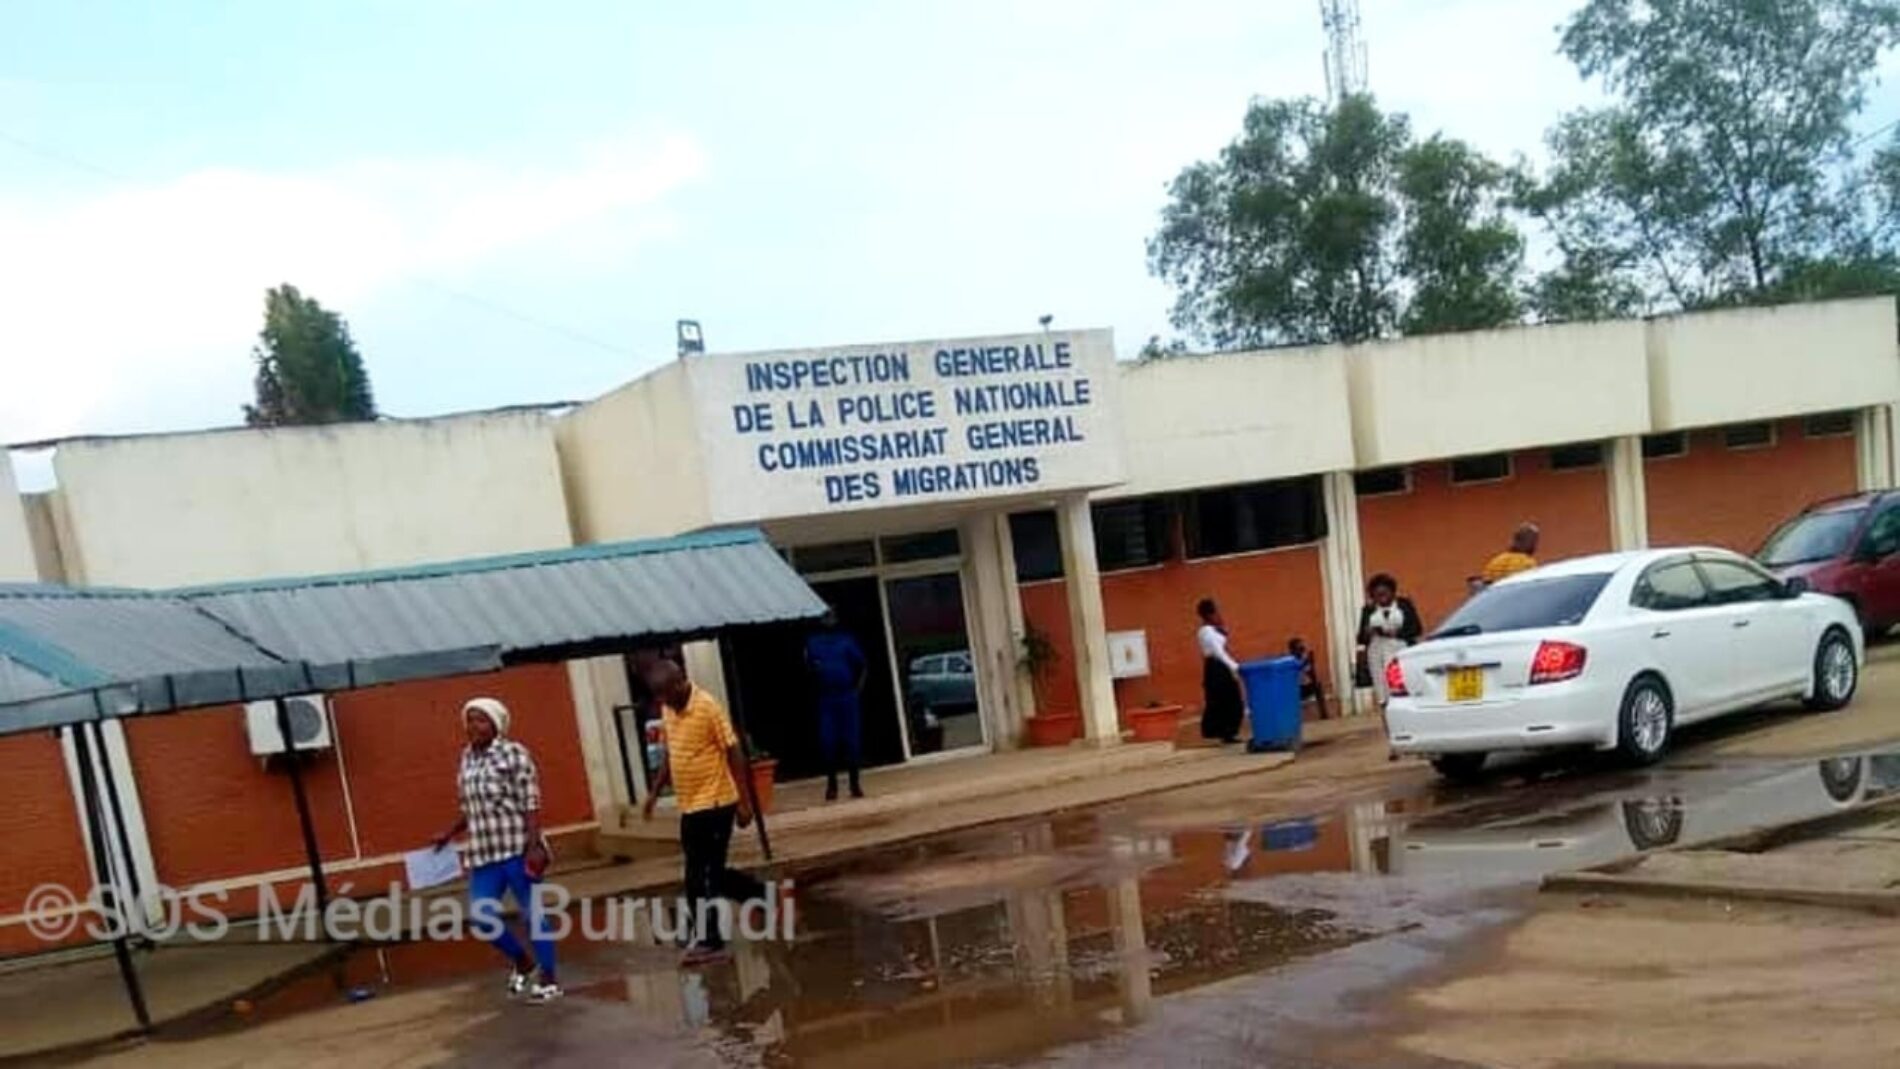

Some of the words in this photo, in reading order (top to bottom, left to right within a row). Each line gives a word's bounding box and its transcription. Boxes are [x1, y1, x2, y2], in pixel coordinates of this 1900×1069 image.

[746, 353, 909, 392] INSPECTION
[935, 343, 1072, 377] GENERALE
[734, 404, 773, 433] DE
[787, 398, 825, 429] LA
[839, 391, 935, 424] POLICE
[954, 379, 1090, 416] NATIONALE
[759, 428, 948, 471] COMMISSARIAT
[966, 417, 1083, 450] GENERAL
[825, 472, 880, 503] DES
[893, 457, 1040, 496] MIGRATIONS
